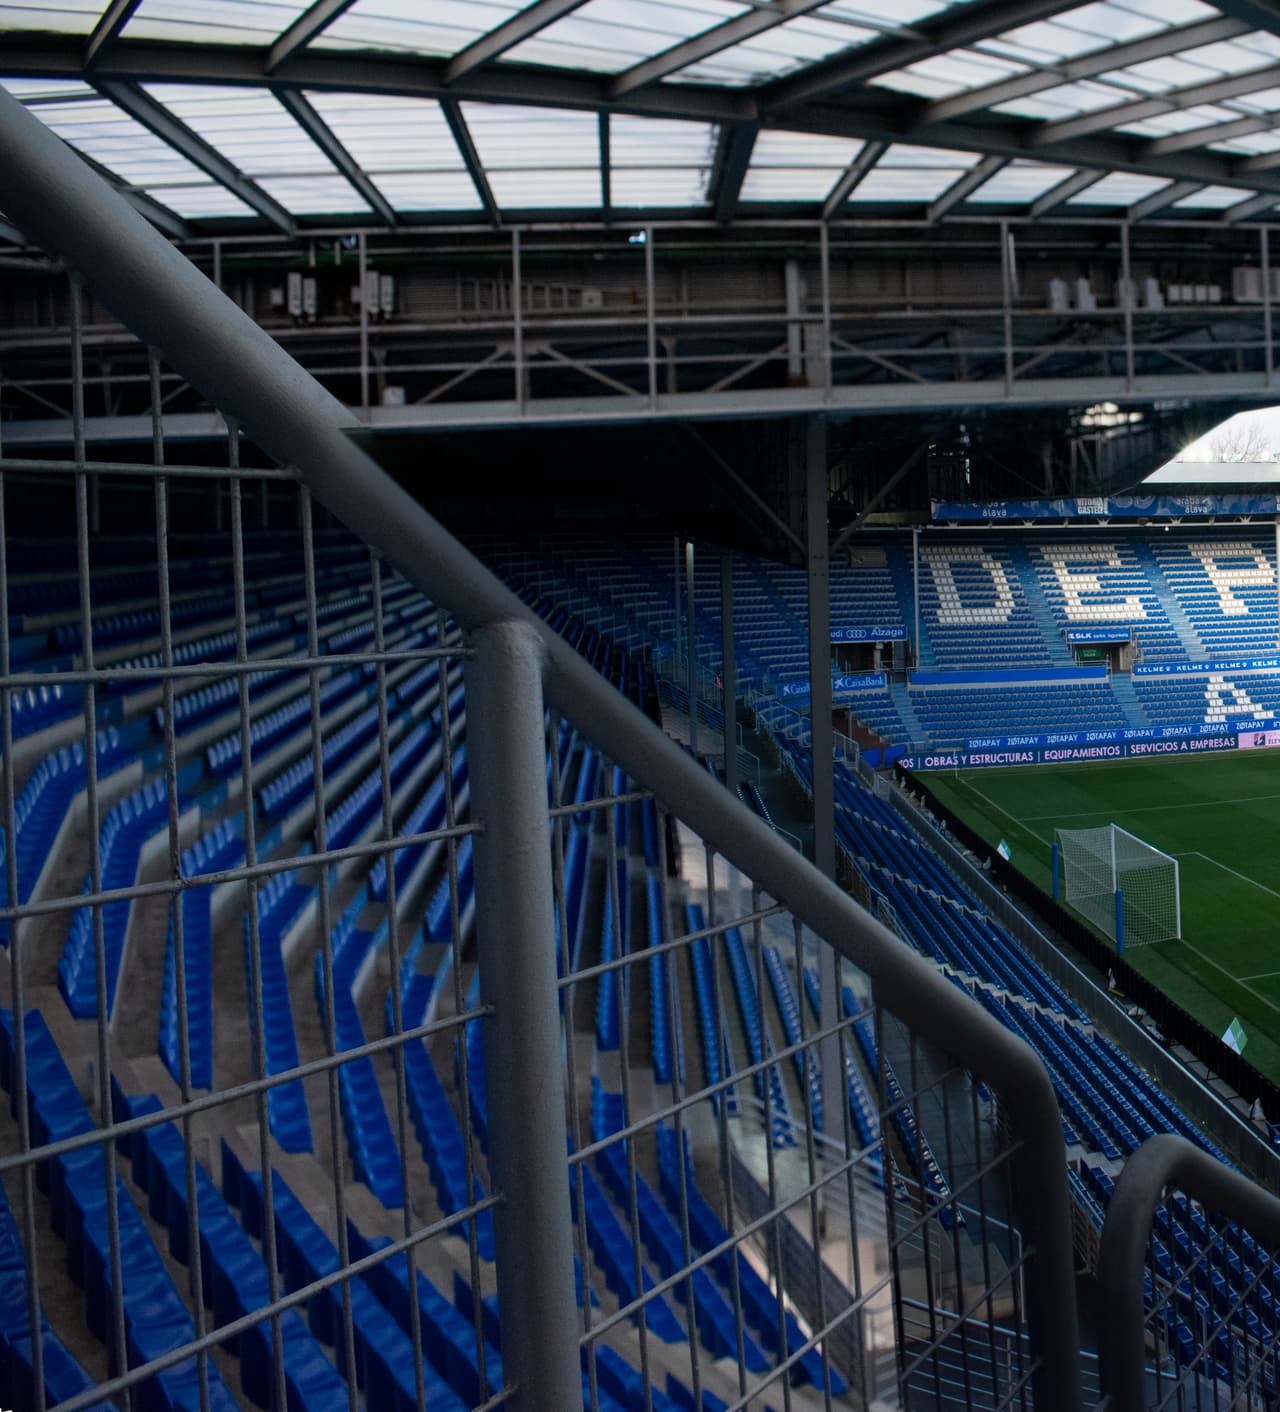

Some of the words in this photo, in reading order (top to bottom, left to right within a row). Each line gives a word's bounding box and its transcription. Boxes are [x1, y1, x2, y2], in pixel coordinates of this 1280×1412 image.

[871, 627, 903, 638] Alzaga
[844, 676, 885, 689] CaixaBank
[924, 755, 958, 767] OBRAS
[961, 755, 967, 765] Y
[970, 751, 1033, 765] ESTRUCTURAS
[1044, 745, 1120, 760] EQUIPAMIENTOS
[1130, 740, 1178, 754] SERVICIOS
[1181, 740, 1188, 750] A
[1190, 737, 1235, 750] EMPRESAS
